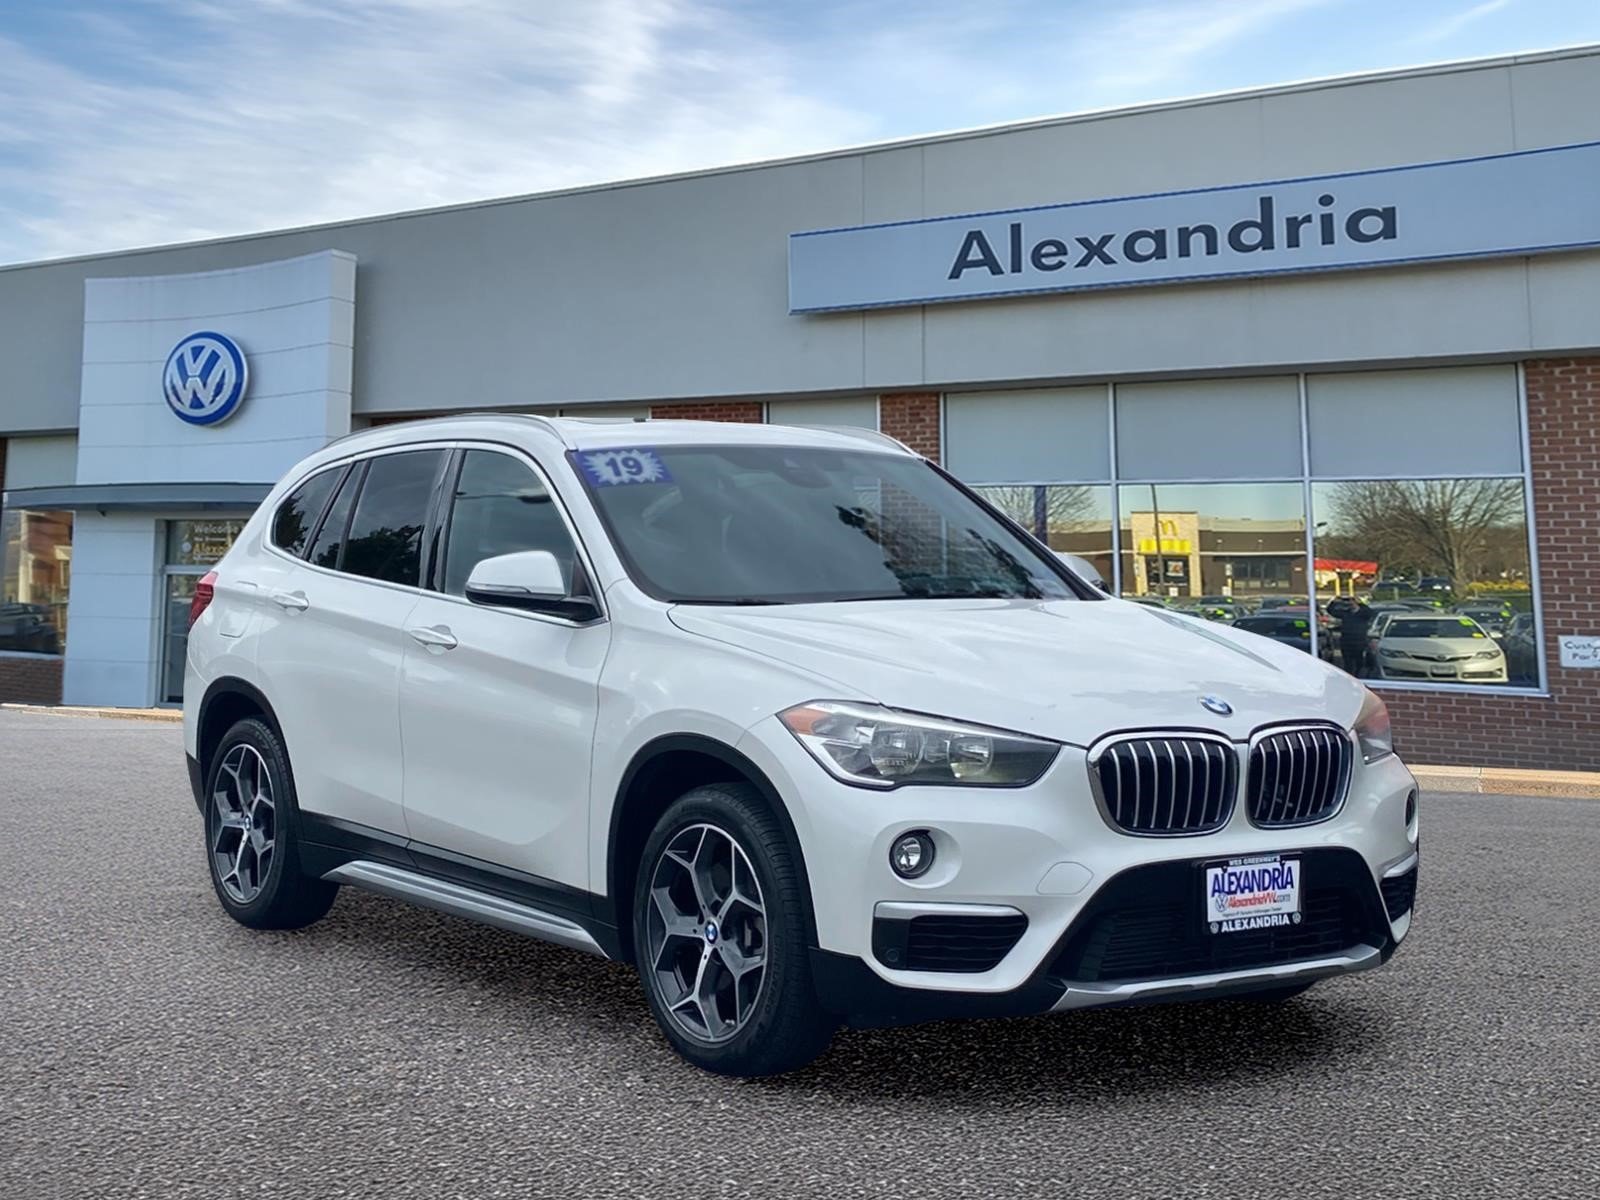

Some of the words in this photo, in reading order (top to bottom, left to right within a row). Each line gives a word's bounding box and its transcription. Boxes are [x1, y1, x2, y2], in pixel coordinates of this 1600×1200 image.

[947, 193, 1398, 280] Alexandria
[605, 456, 643, 477] 19
[1211, 866, 1293, 897] ALEXANDRIA
[1221, 914, 1290, 933] ALEXANDRIA
